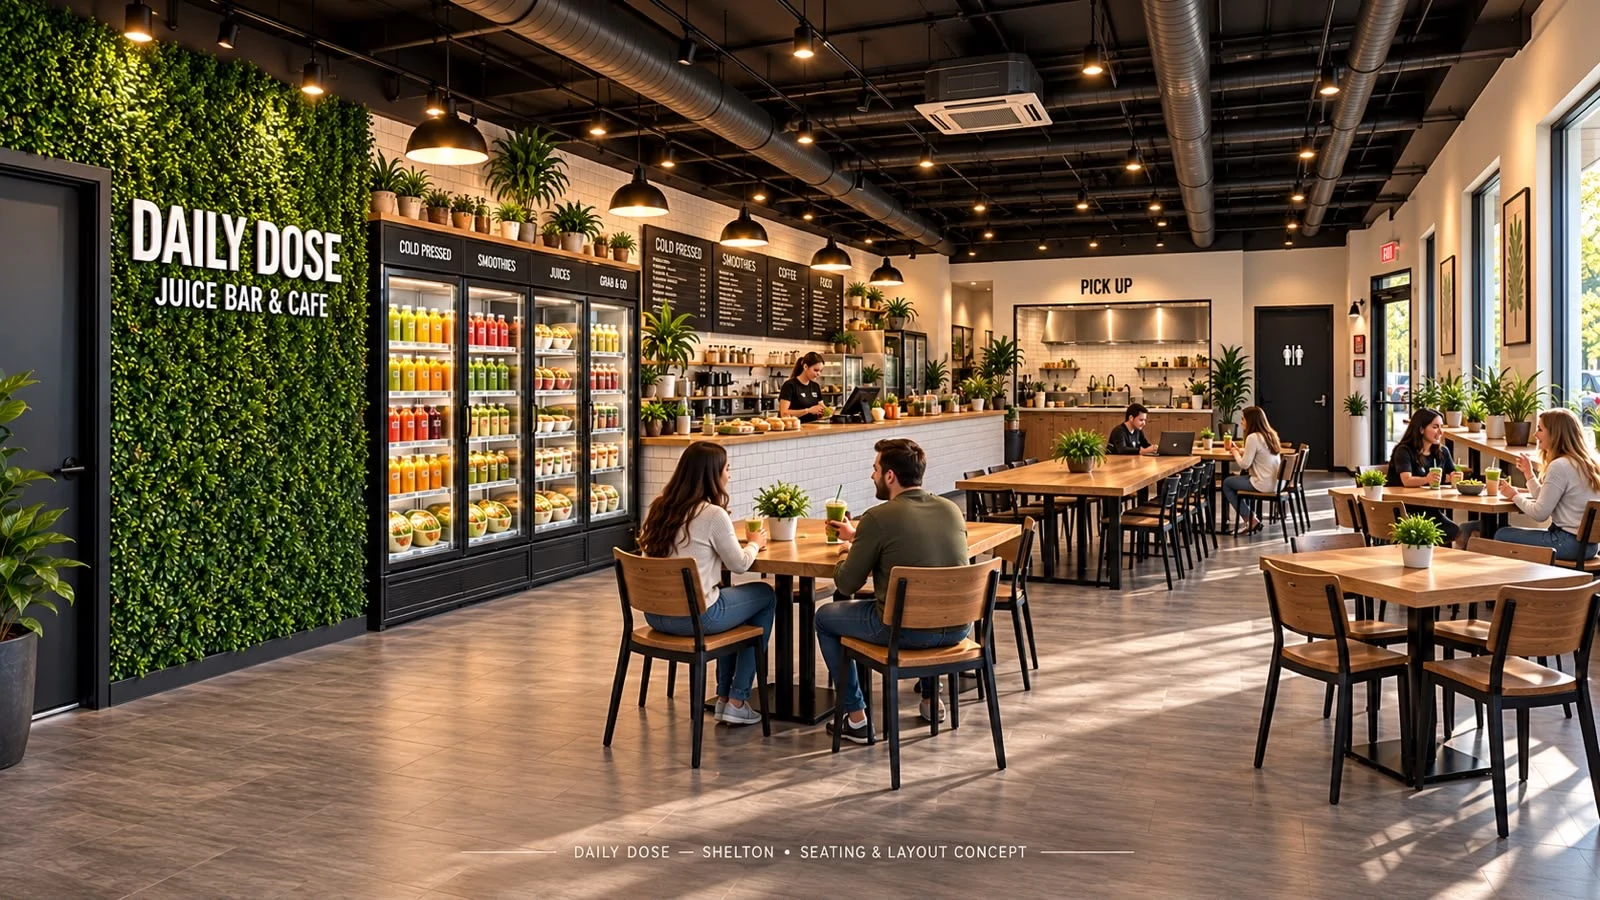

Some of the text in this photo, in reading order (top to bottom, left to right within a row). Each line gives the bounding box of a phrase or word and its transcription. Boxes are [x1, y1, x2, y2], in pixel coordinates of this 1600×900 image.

[132, 198, 342, 284] DAILY DOSE
[655, 237, 702, 260] COLD PRESSED
[399, 240, 452, 262] COLD PRESSED
[477, 253, 516, 273] SMOOTHIES
[722, 253, 756, 272] SMOOTHIES
[549, 267, 571, 281] JUICES
[600, 275, 628, 290] GRAB & GO
[778, 266, 797, 281] COFFEE
[820, 276, 833, 289] FOOD
[1080, 277, 1133, 295] PICK UP
[155, 277, 329, 318] JUICE BAR & CAFE
